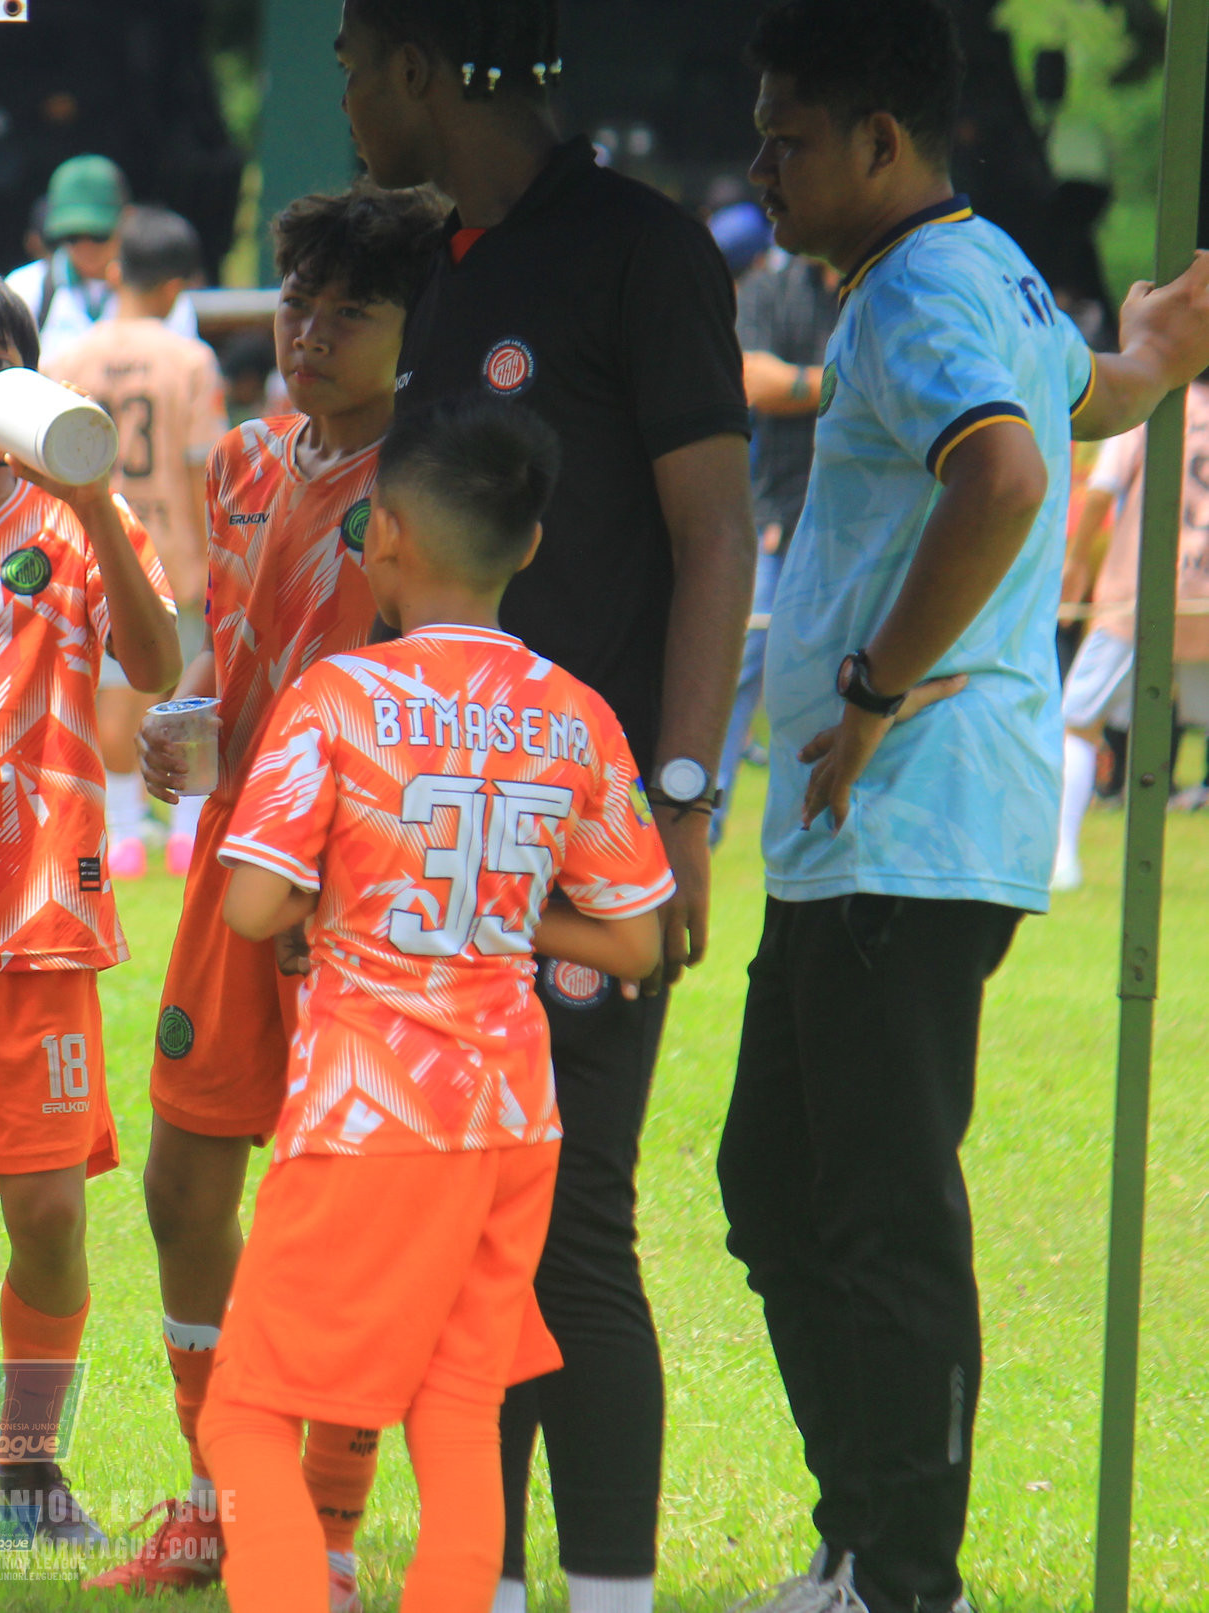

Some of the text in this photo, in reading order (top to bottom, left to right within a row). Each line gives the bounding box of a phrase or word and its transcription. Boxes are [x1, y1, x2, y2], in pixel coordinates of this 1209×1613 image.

[229, 503, 270, 526] ERUKOV
[374, 698, 590, 766] BIMASENA
[389, 773, 573, 957] 35
[42, 1033, 89, 1098] 18
[42, 1101, 89, 1114] ERUKOV
